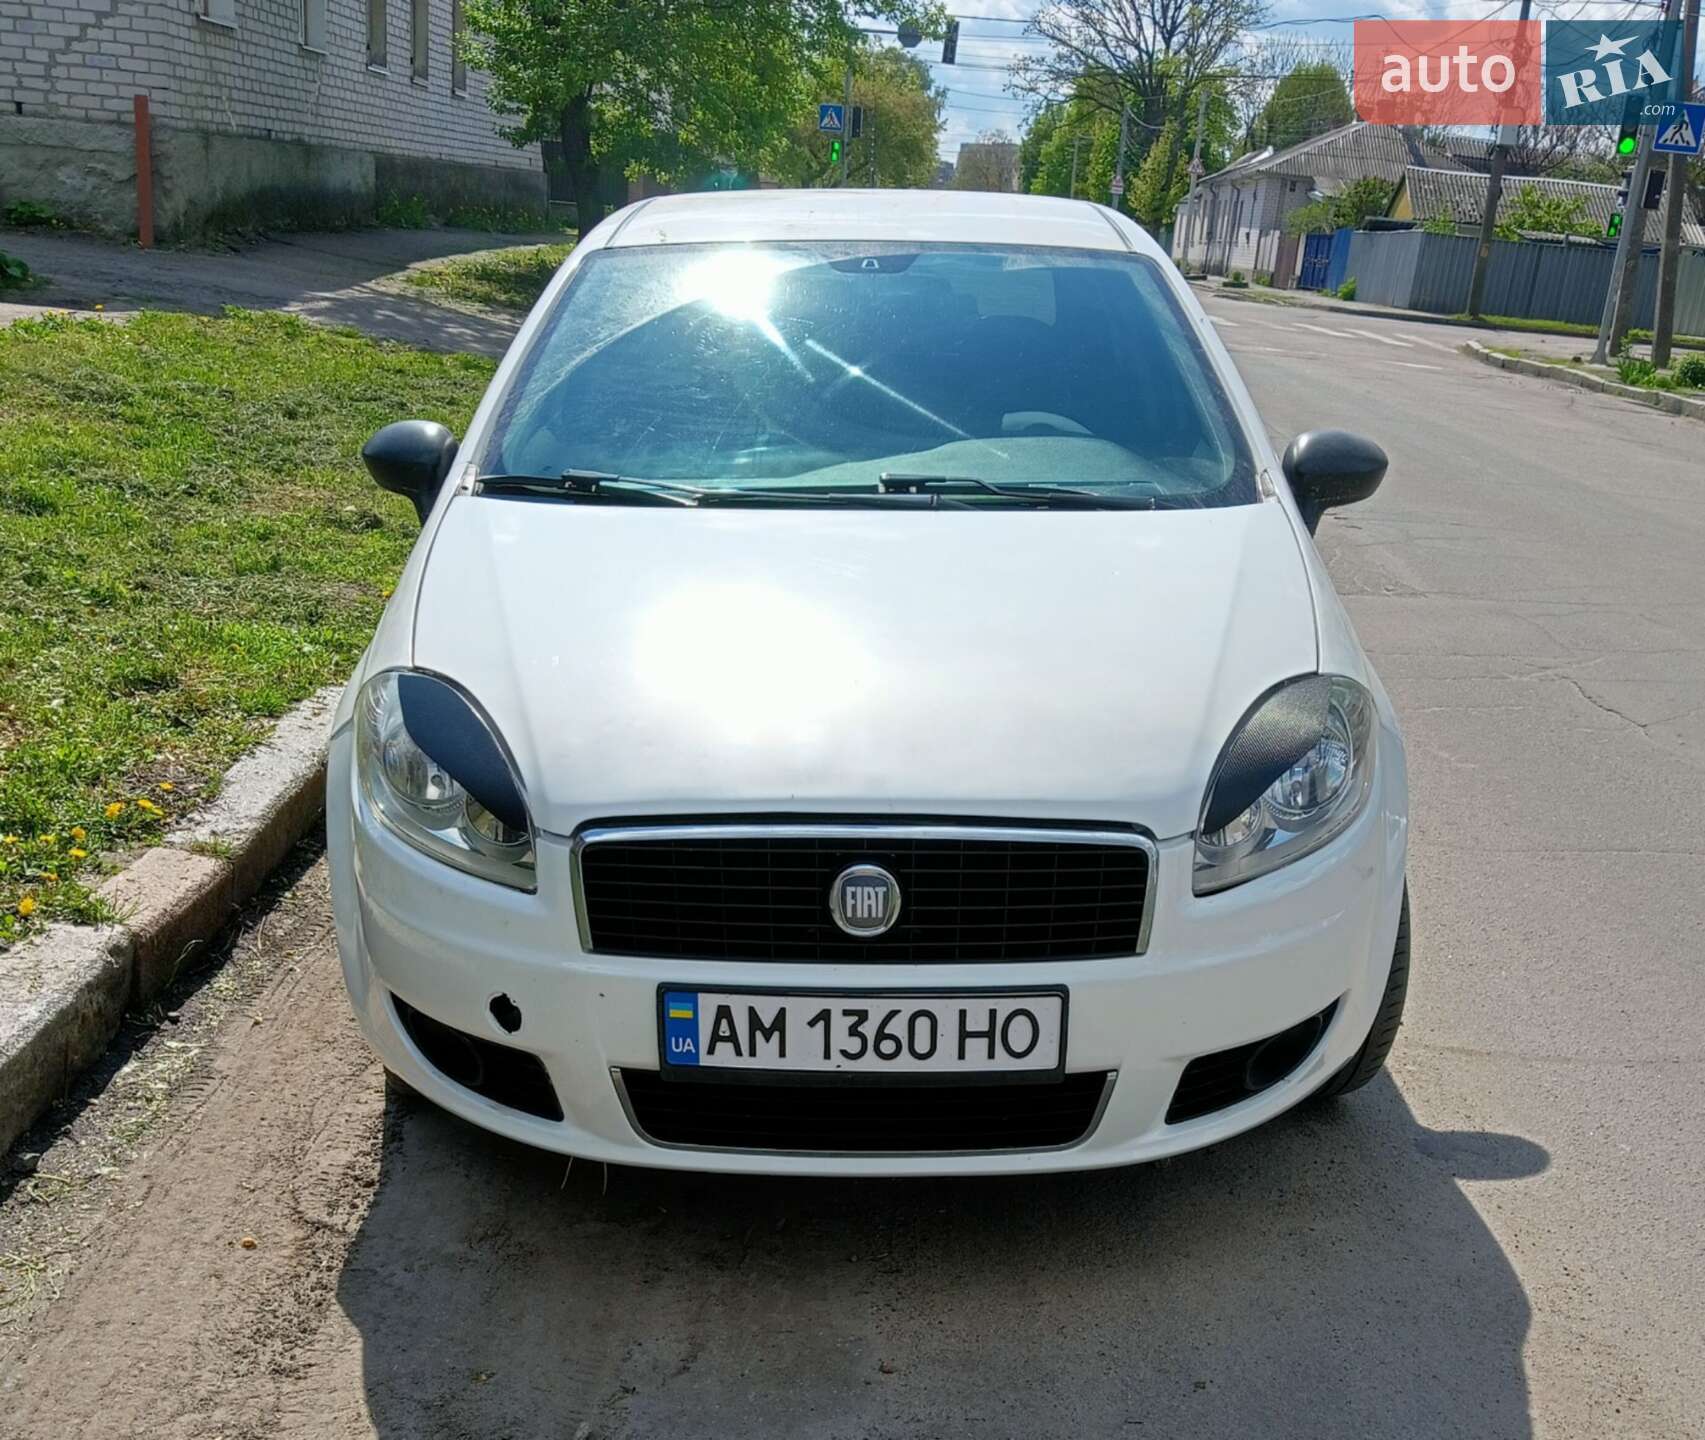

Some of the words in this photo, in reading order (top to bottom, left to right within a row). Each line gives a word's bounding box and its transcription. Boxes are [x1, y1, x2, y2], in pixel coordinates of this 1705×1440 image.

[846, 886, 887, 918] FIAT
[671, 1037, 696, 1054] UA
[706, 1005, 786, 1058] AM
[807, 1008, 938, 1061] 1360
[957, 1008, 1040, 1060] HO
